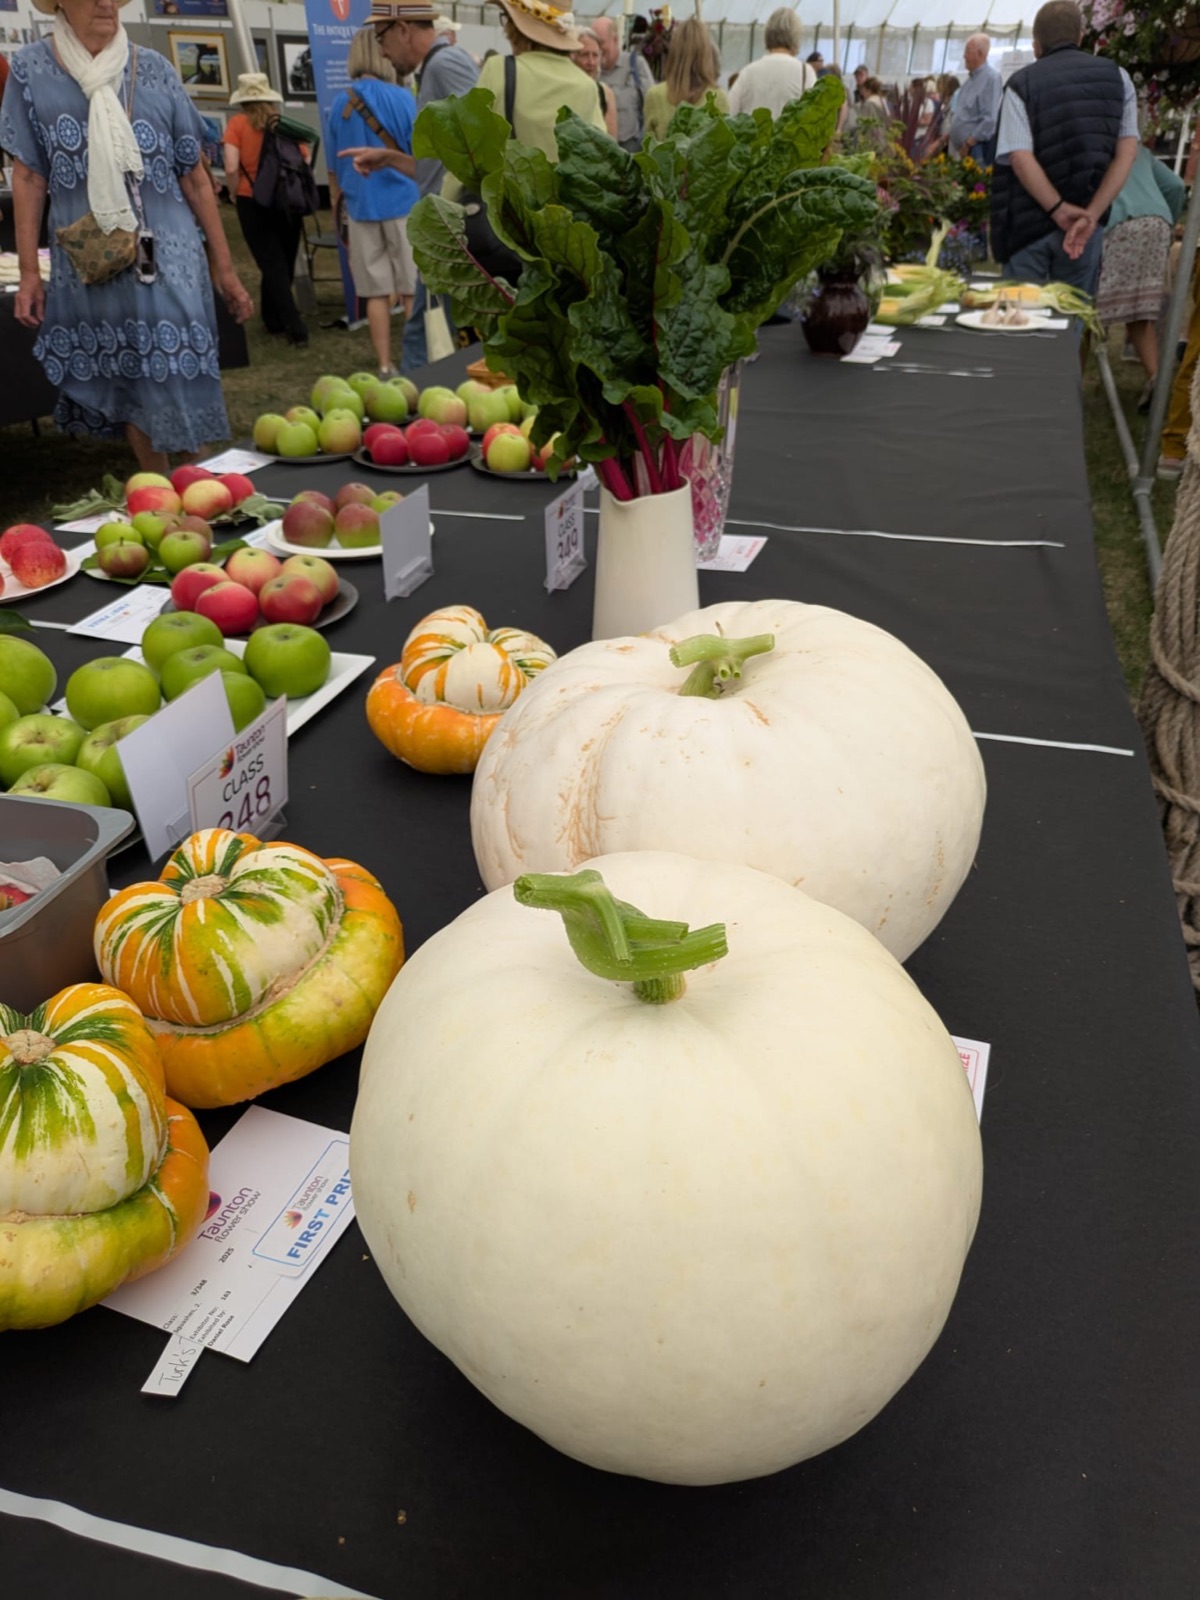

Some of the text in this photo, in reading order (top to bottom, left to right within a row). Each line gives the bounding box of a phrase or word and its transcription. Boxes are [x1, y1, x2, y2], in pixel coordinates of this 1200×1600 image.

[223, 753, 264, 802] CLASS
[197, 1187, 254, 1240] Taunton
[287, 1169, 351, 1259] FIRST PRI
[291, 1175, 324, 1210] Taunton
[214, 1190, 262, 1243] flower show
[218, 1247, 234, 1263] 2025
[207, 1315, 235, 1347] Daniel Rose
[158, 1349, 197, 1386] Turk's
